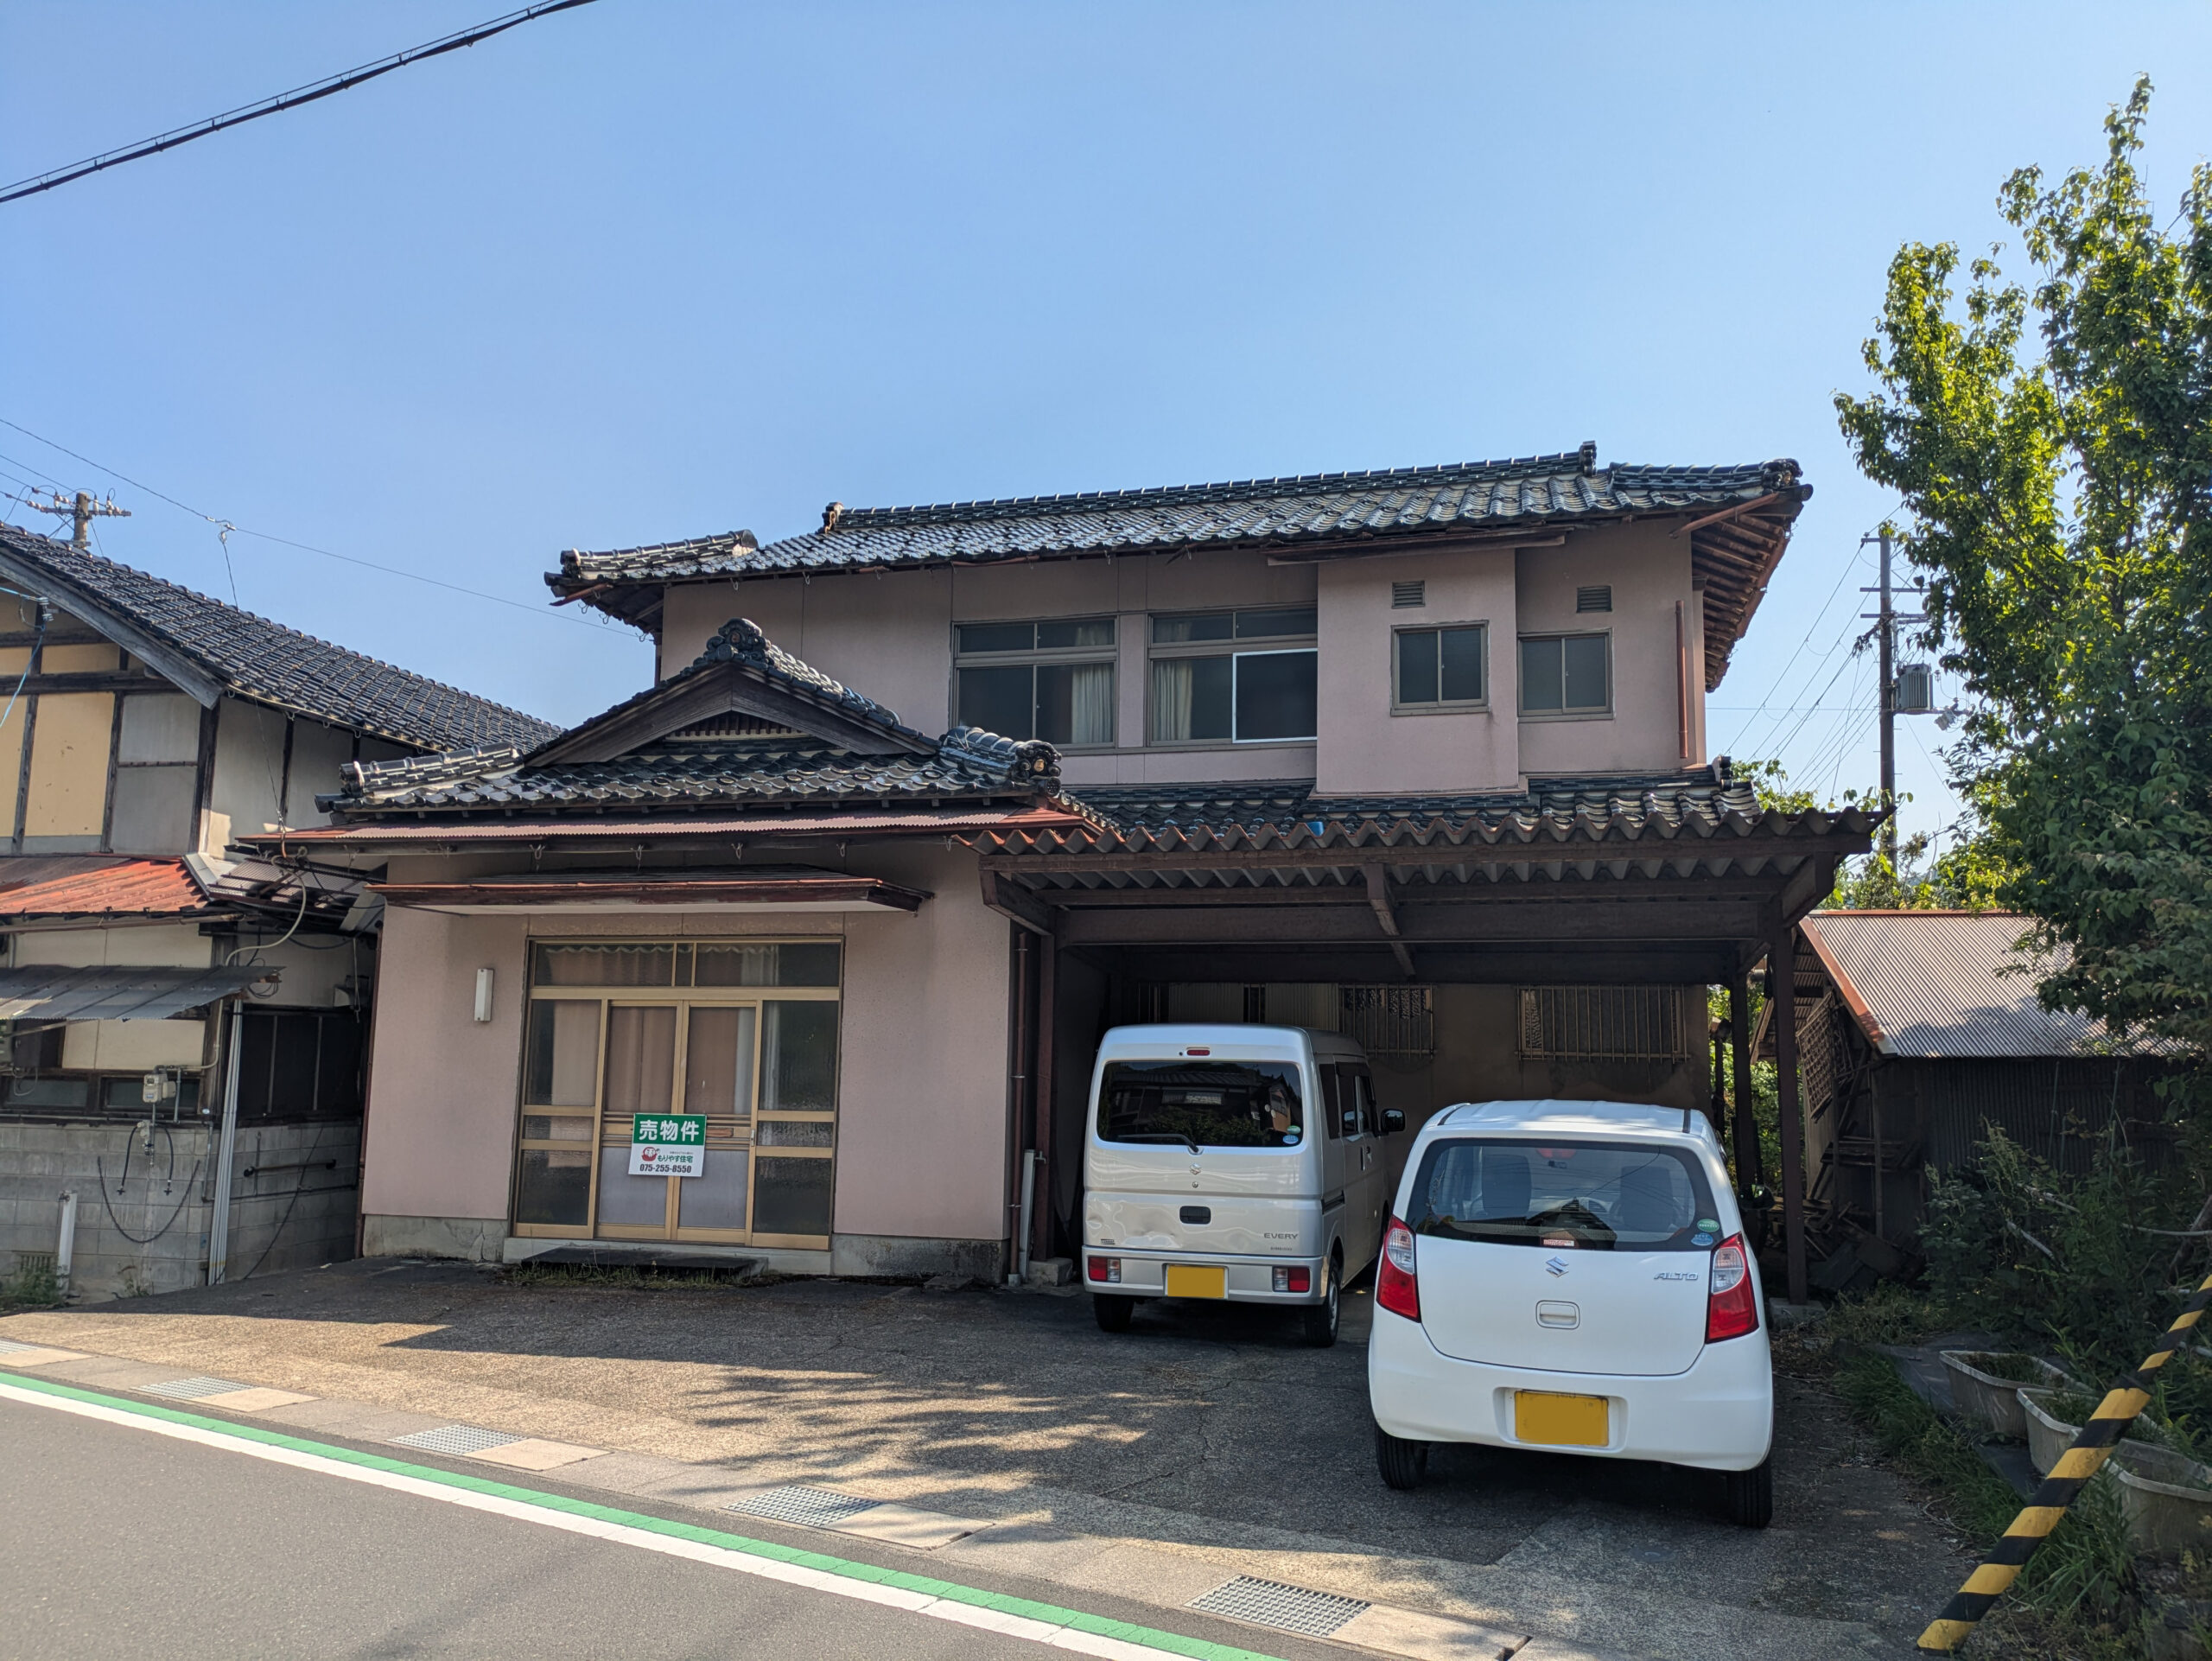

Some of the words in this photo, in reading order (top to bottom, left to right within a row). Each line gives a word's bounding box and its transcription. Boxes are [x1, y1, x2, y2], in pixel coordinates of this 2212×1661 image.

[639, 1119, 699, 1142] 売物件
[658, 1155, 693, 1163] もりやす住宅
[639, 1163, 692, 1174] 075-255-8550
[1654, 1272, 1699, 1281] ALTO
